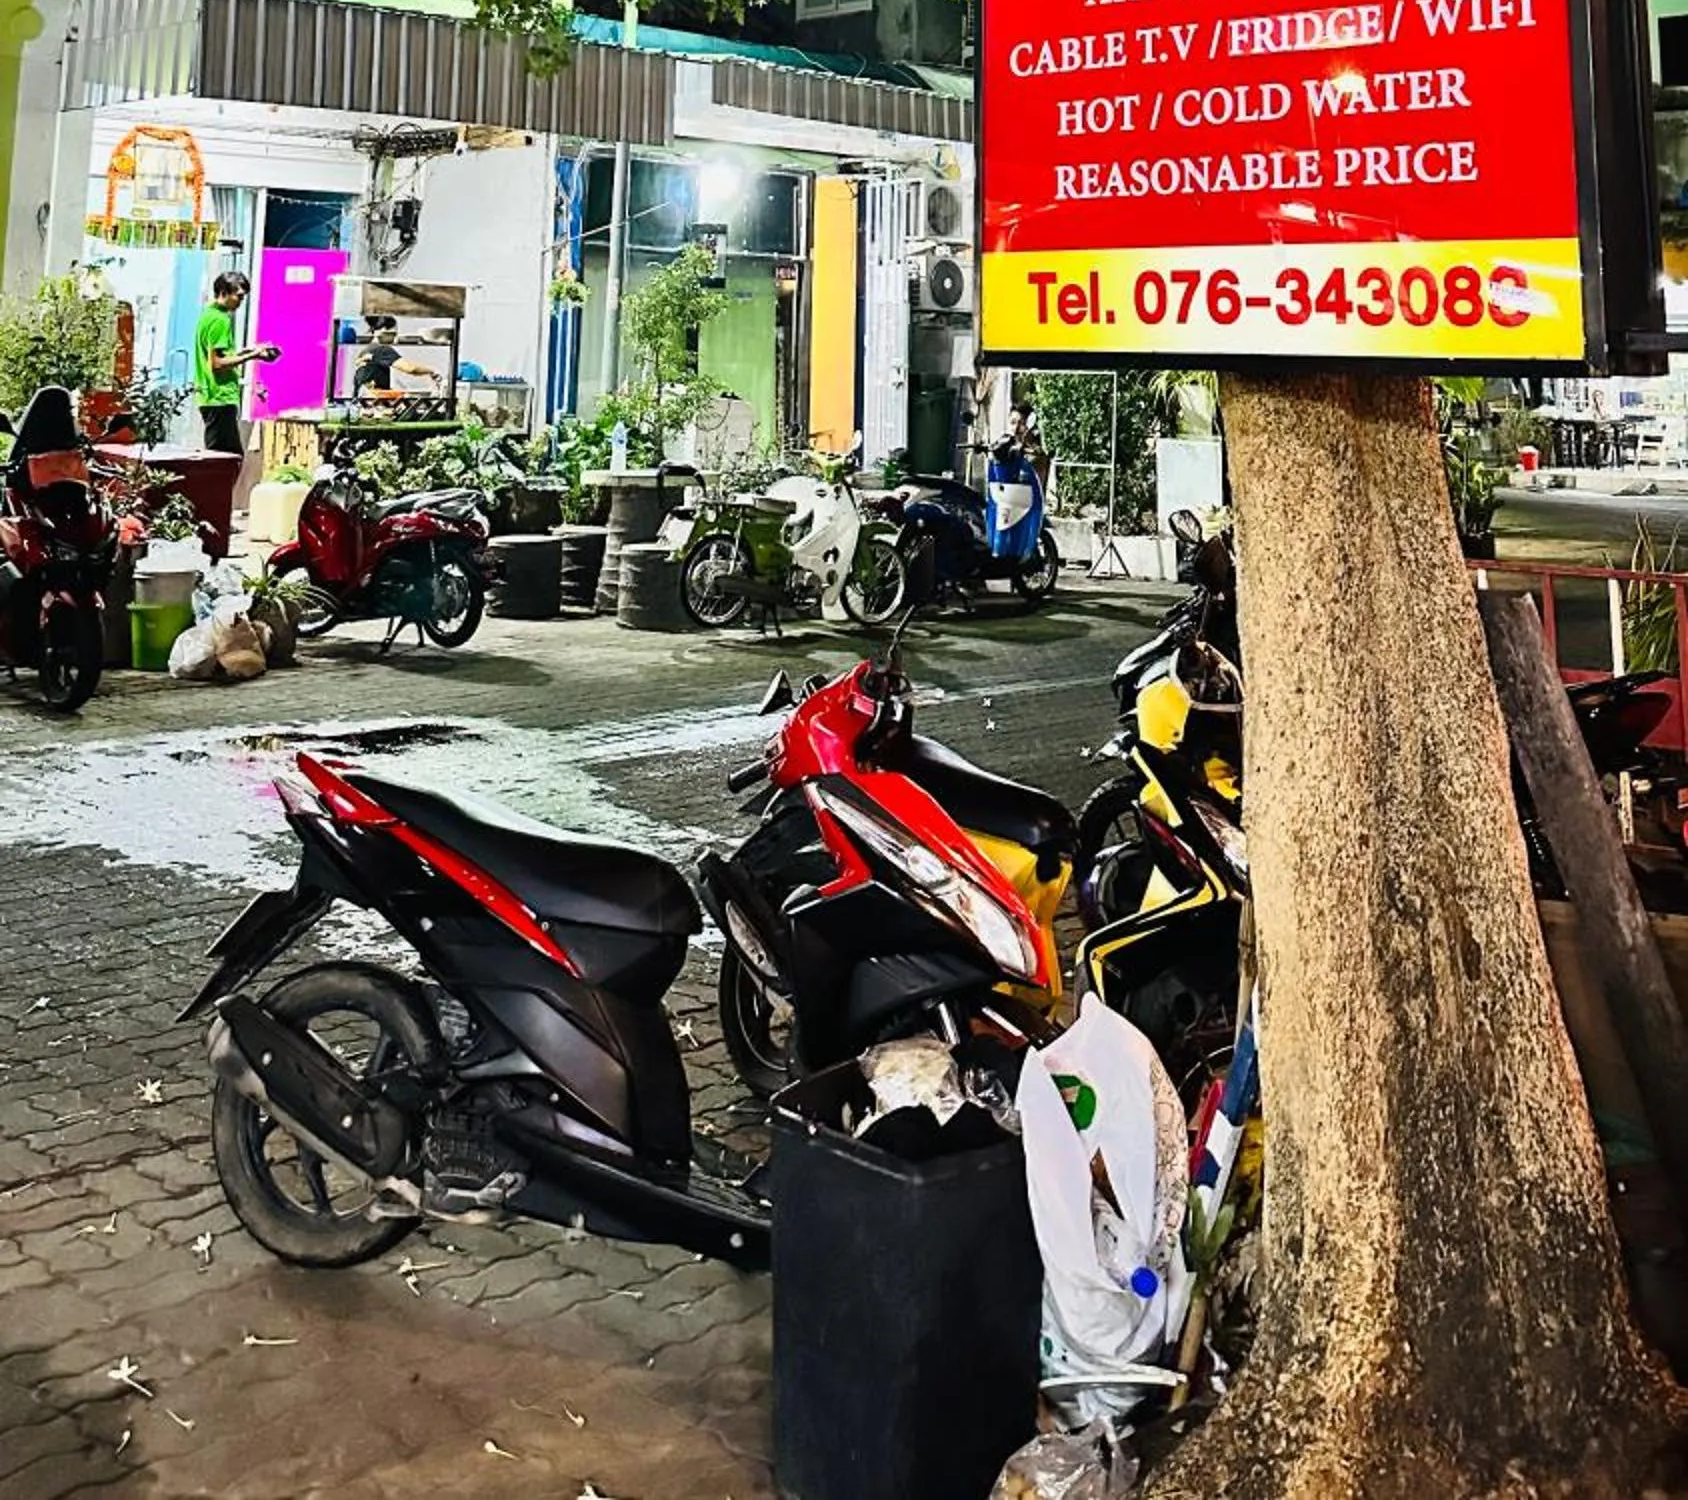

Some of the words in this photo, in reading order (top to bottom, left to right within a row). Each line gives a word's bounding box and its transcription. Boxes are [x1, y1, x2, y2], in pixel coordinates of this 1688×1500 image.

[1010, 33, 1127, 77] CABLE
[1136, 23, 1199, 63] T.V
[1229, 6, 1382, 56] FRIDGE
[1058, 94, 1139, 135] HOT
[1174, 83, 1291, 126] COLD
[1304, 68, 1471, 117] WATER
[1056, 149, 1322, 200] REASONABLE
[1334, 141, 1478, 187] PRICE
[1028, 271, 1116, 325] Tel.
